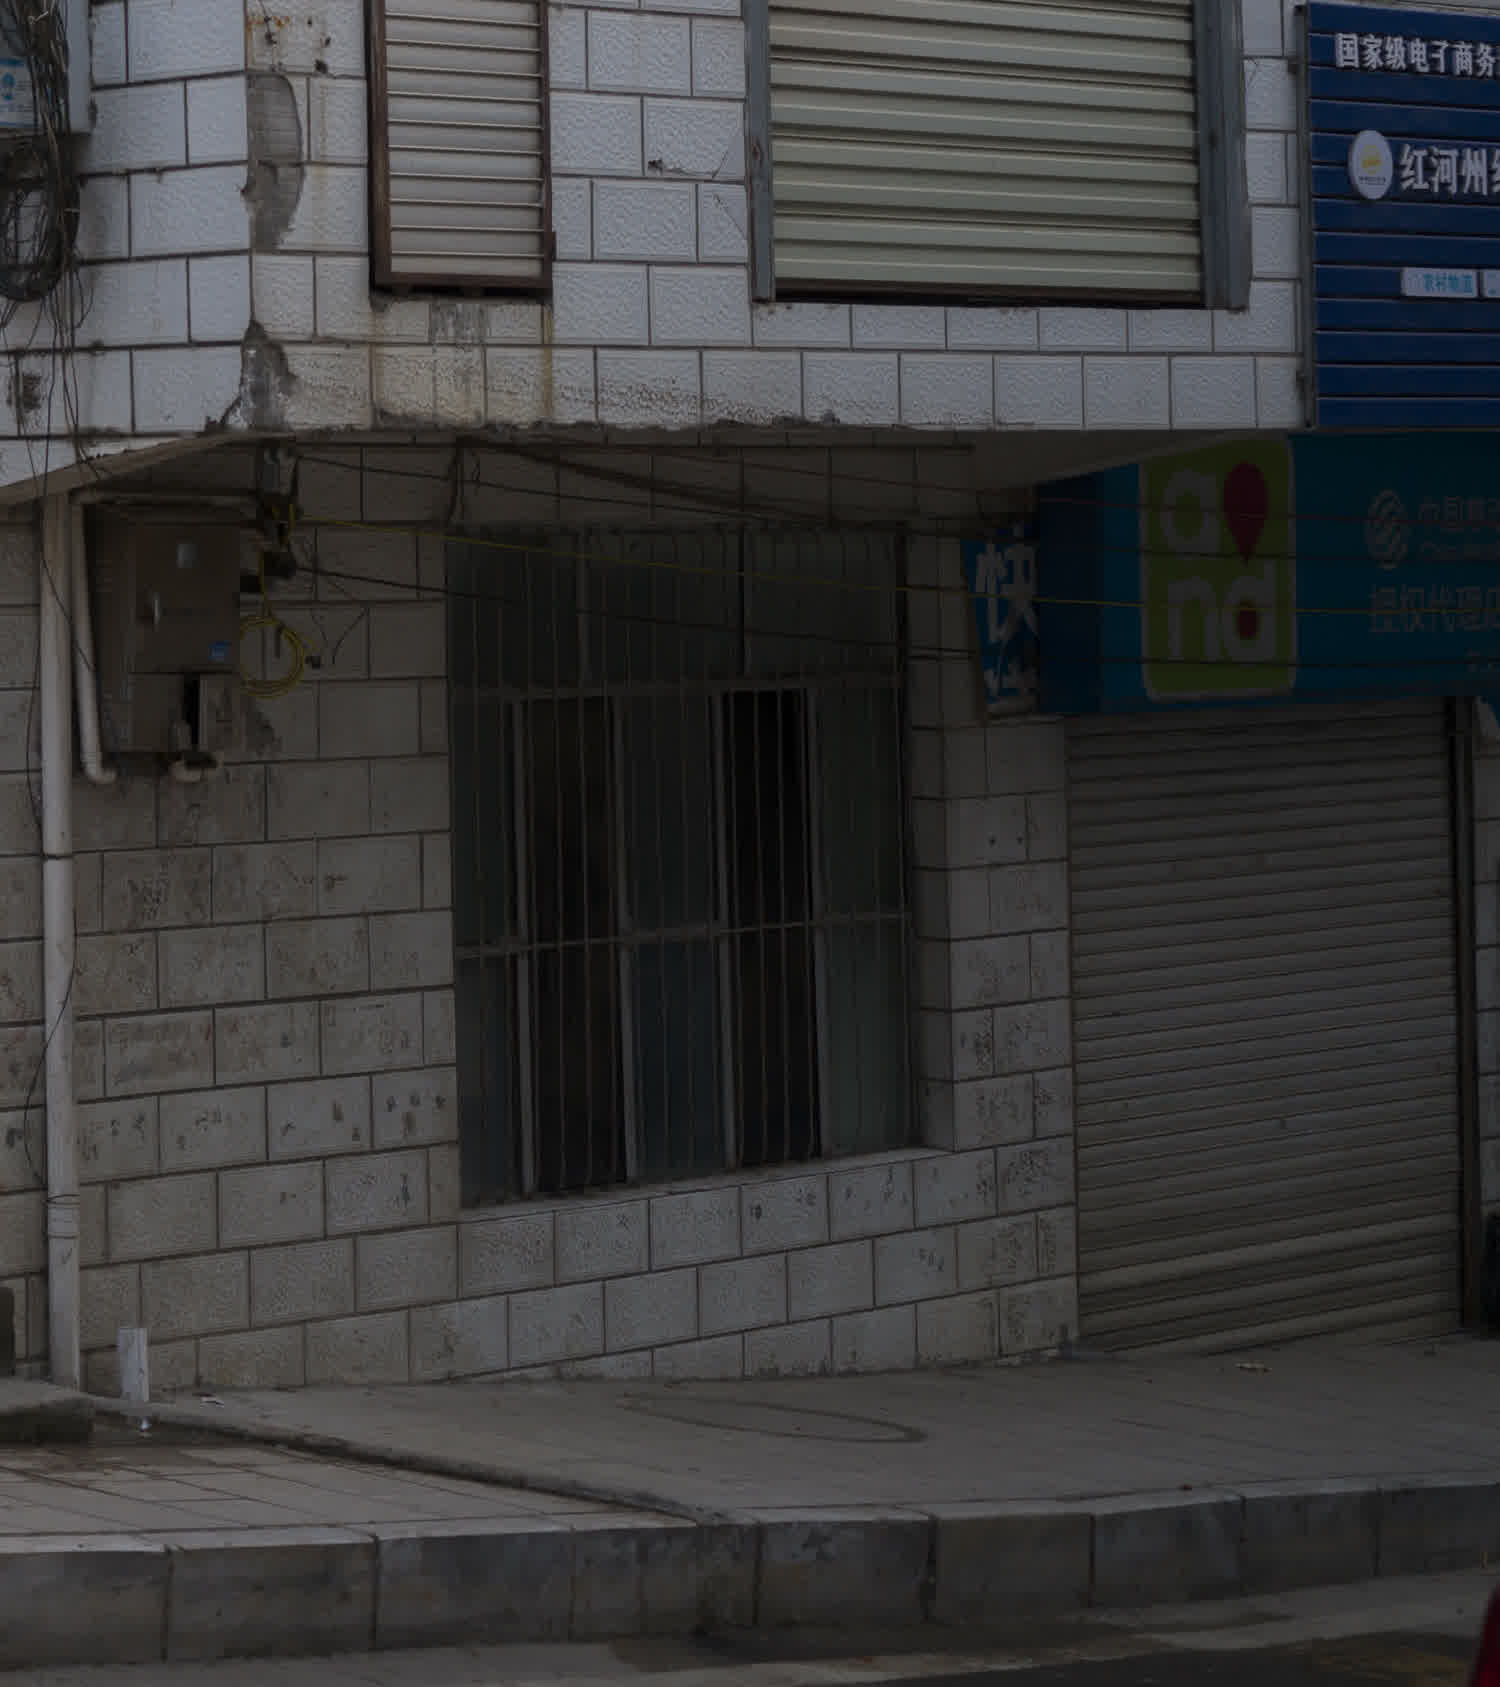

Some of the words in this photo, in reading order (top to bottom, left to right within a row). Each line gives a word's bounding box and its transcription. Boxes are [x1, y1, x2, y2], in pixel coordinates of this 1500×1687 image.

[1335, 33, 1500, 78] 国家级电子商务
